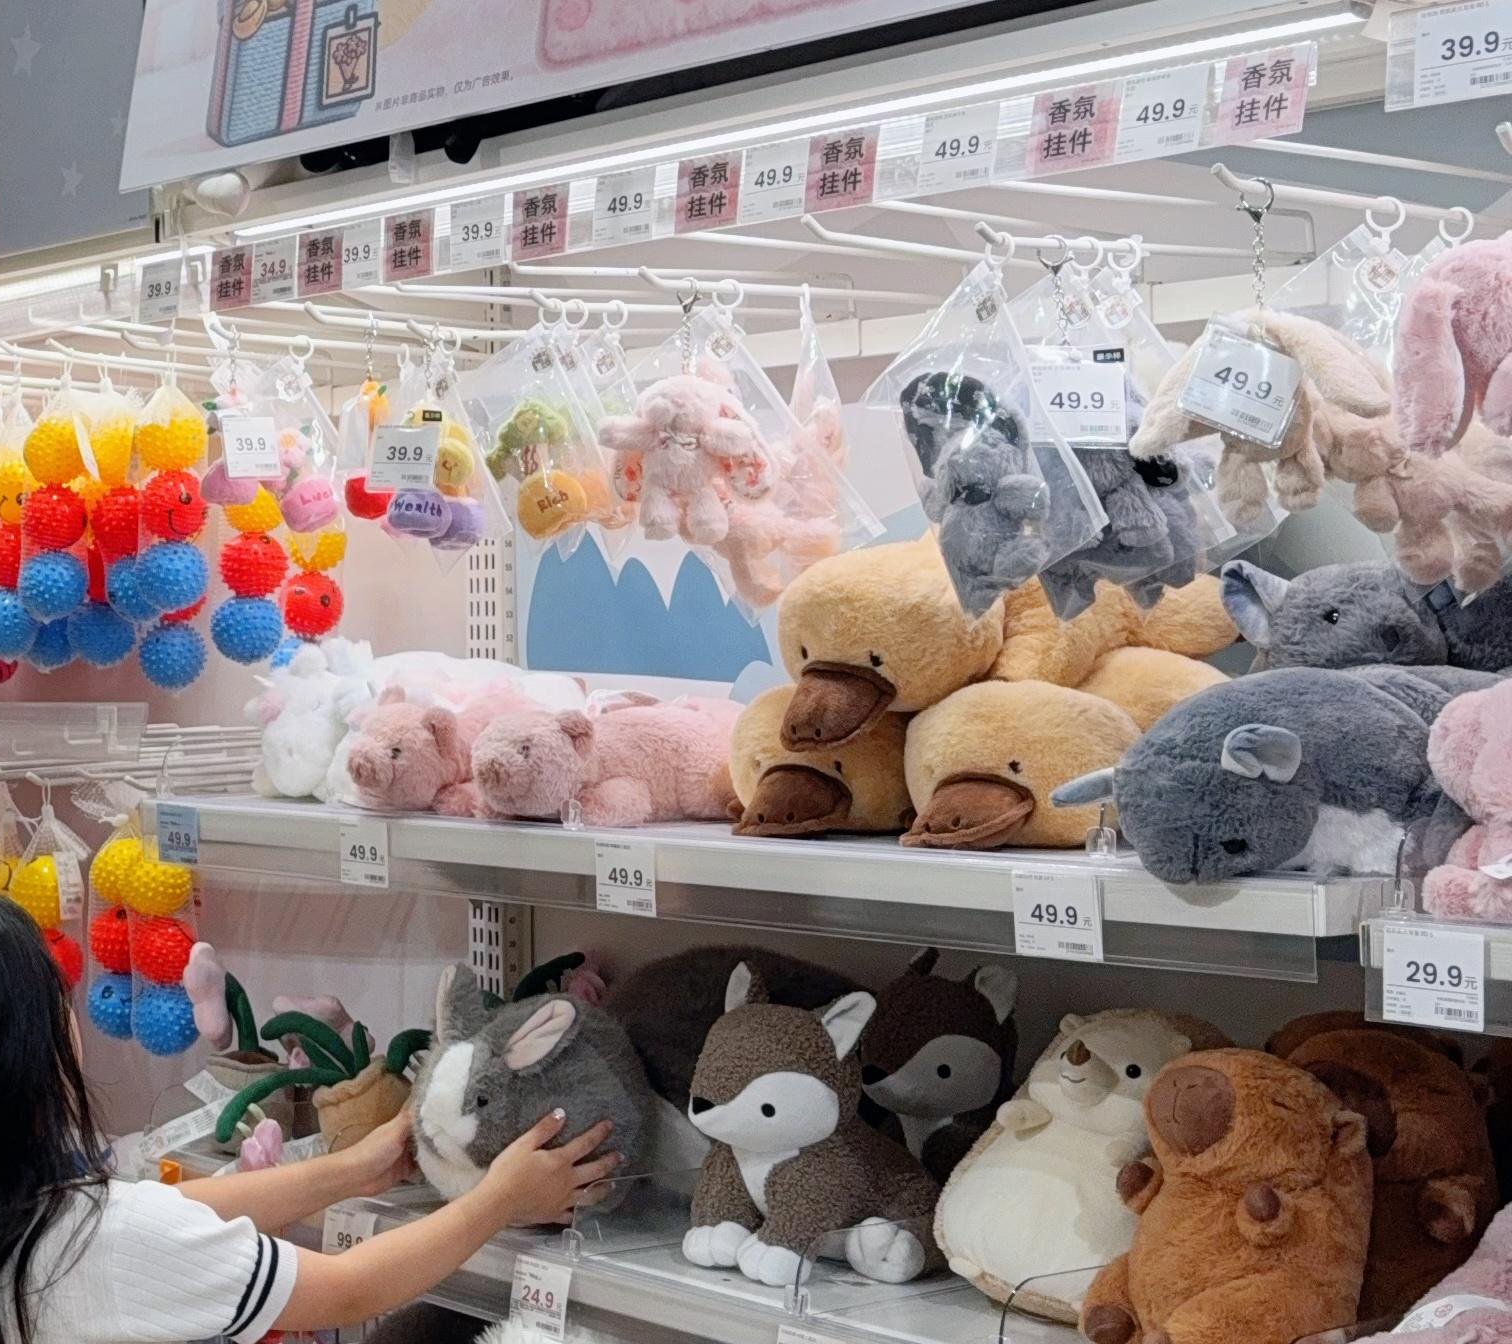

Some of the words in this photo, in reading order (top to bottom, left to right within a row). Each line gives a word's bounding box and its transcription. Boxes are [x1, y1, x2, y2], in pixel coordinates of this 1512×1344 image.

[1441, 31, 1500, 61] 39.9
[1241, 58, 1296, 92] 香氛
[1048, 95, 1098, 126] 香氛
[1137, 98, 1186, 124] 49.9
[1235, 93, 1289, 127] 挂件
[823, 136, 866, 165] 香氛
[934, 135, 980, 160] 49.9
[1043, 127, 1093, 160] 挂件
[690, 161, 730, 189] 香氛
[754, 165, 794, 189] 49.9
[819, 167, 863, 198] 挂件
[524, 193, 559, 220] 香氛
[607, 192, 644, 215] 49.9
[687, 191, 728, 219] 挂件
[393, 219, 423, 243] 香氛
[461, 221, 494, 243] 39.9
[522, 221, 558, 248] 挂件
[306, 235, 335, 258] 香氛
[343, 244, 372, 265] 39.9
[391, 245, 422, 271] 挂件
[219, 252, 246, 275] 香氛
[260, 258, 288, 279] 34.9
[305, 261, 335, 285] 挂件
[147, 280, 172, 299] 39.9
[216, 279, 246, 300] 挂件
[1213, 366, 1273, 400] 49.9
[1049, 390, 1105, 410] 49.9
[235, 436, 268, 453] 39.9
[385, 445, 424, 463] 39.9
[392, 497, 443, 519] Wealth
[167, 830, 191, 847] 49.9
[349, 843, 378, 862] 49.9
[608, 867, 643, 887] 49.9
[1030, 903, 1078, 926] 49.9
[1406, 960, 1463, 988] 29.9
[337, 1231, 364, 1249] 99
[522, 1284, 555, 1309] 24.9
